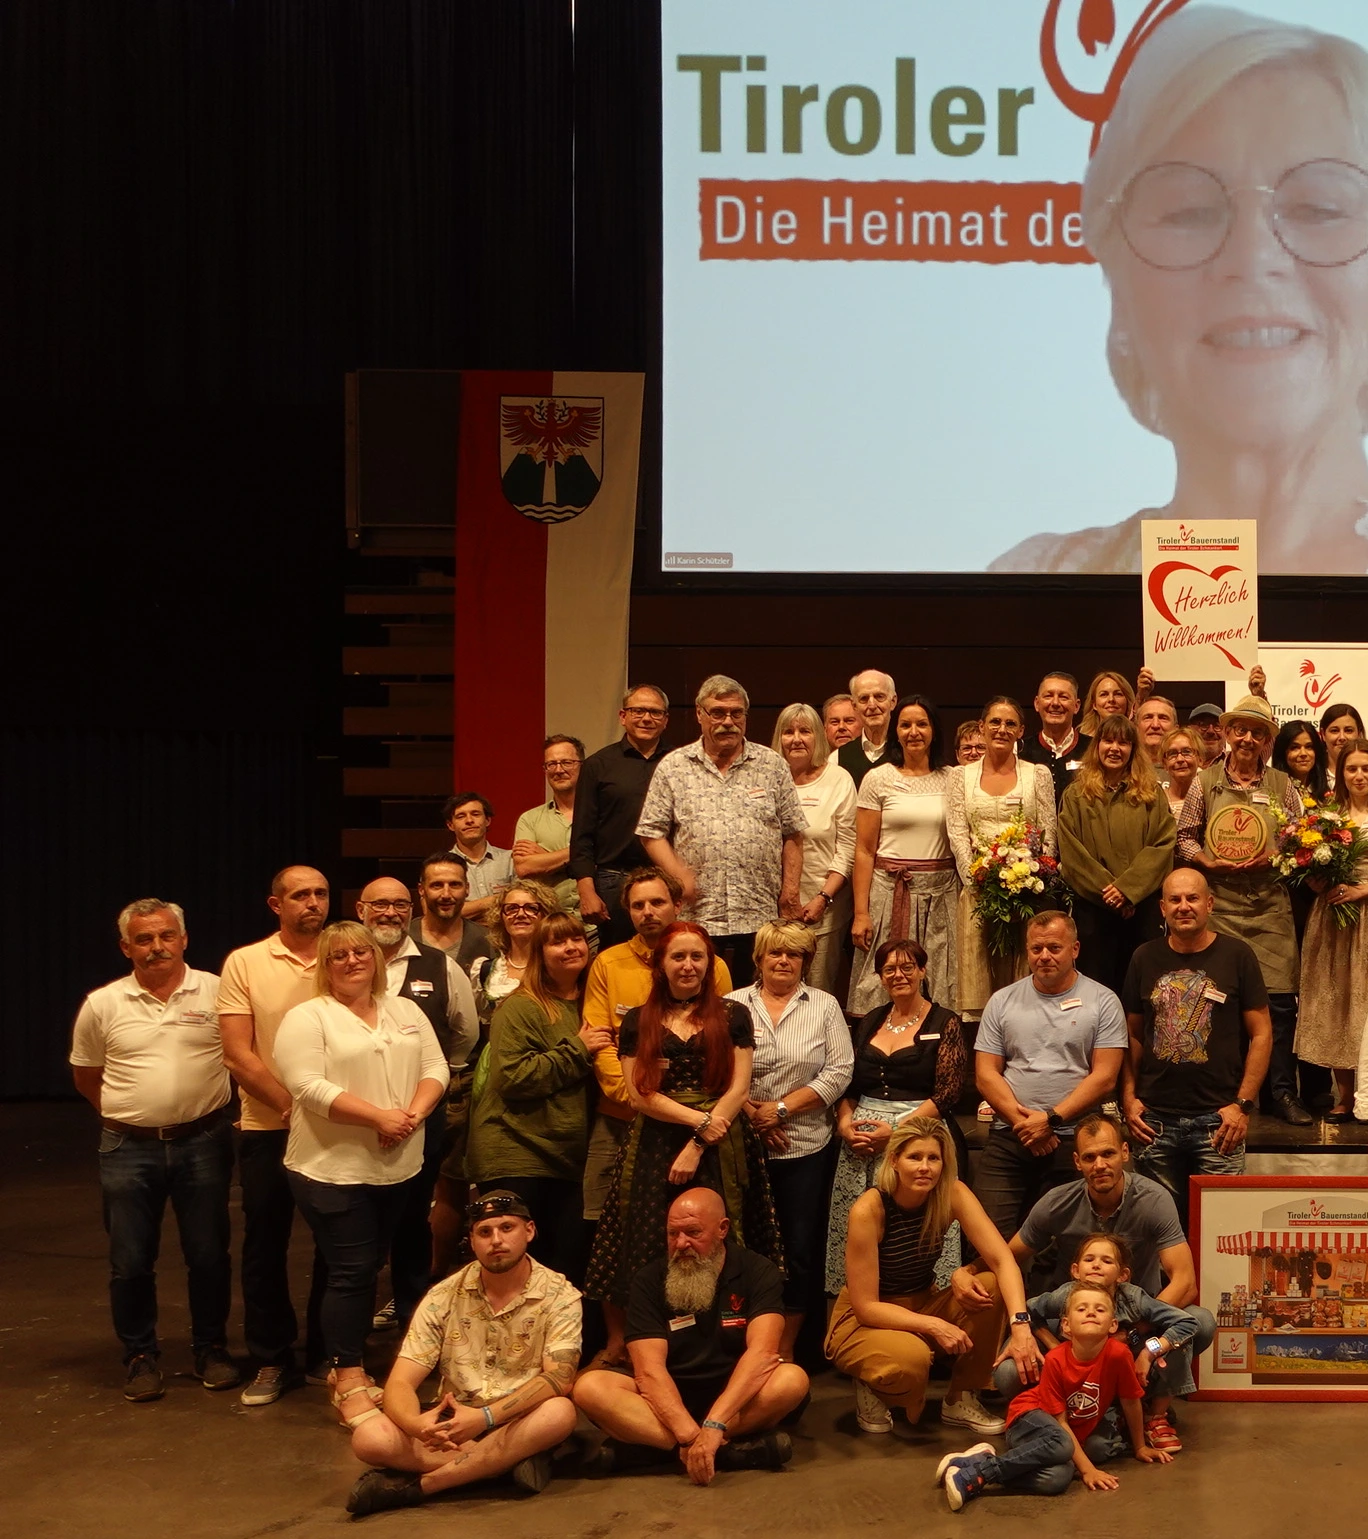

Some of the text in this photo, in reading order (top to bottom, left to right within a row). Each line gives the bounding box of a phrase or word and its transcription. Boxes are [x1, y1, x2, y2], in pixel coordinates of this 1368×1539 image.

[676, 53, 1034, 157] Tiroler
[715, 195, 797, 246] Die
[822, 196, 1008, 248] Heimat
[1028, 198, 1084, 248] de
[1156, 536, 1240, 545] Tiroler Bauernstandl
[677, 556, 696, 565] Karin
[1174, 579, 1249, 614] Herzlich
[1154, 615, 1254, 654] Willkommen!
[1271, 704, 1309, 716] Tiroler
[1287, 1211, 1368, 1219] Tiroler Bauernstandl
